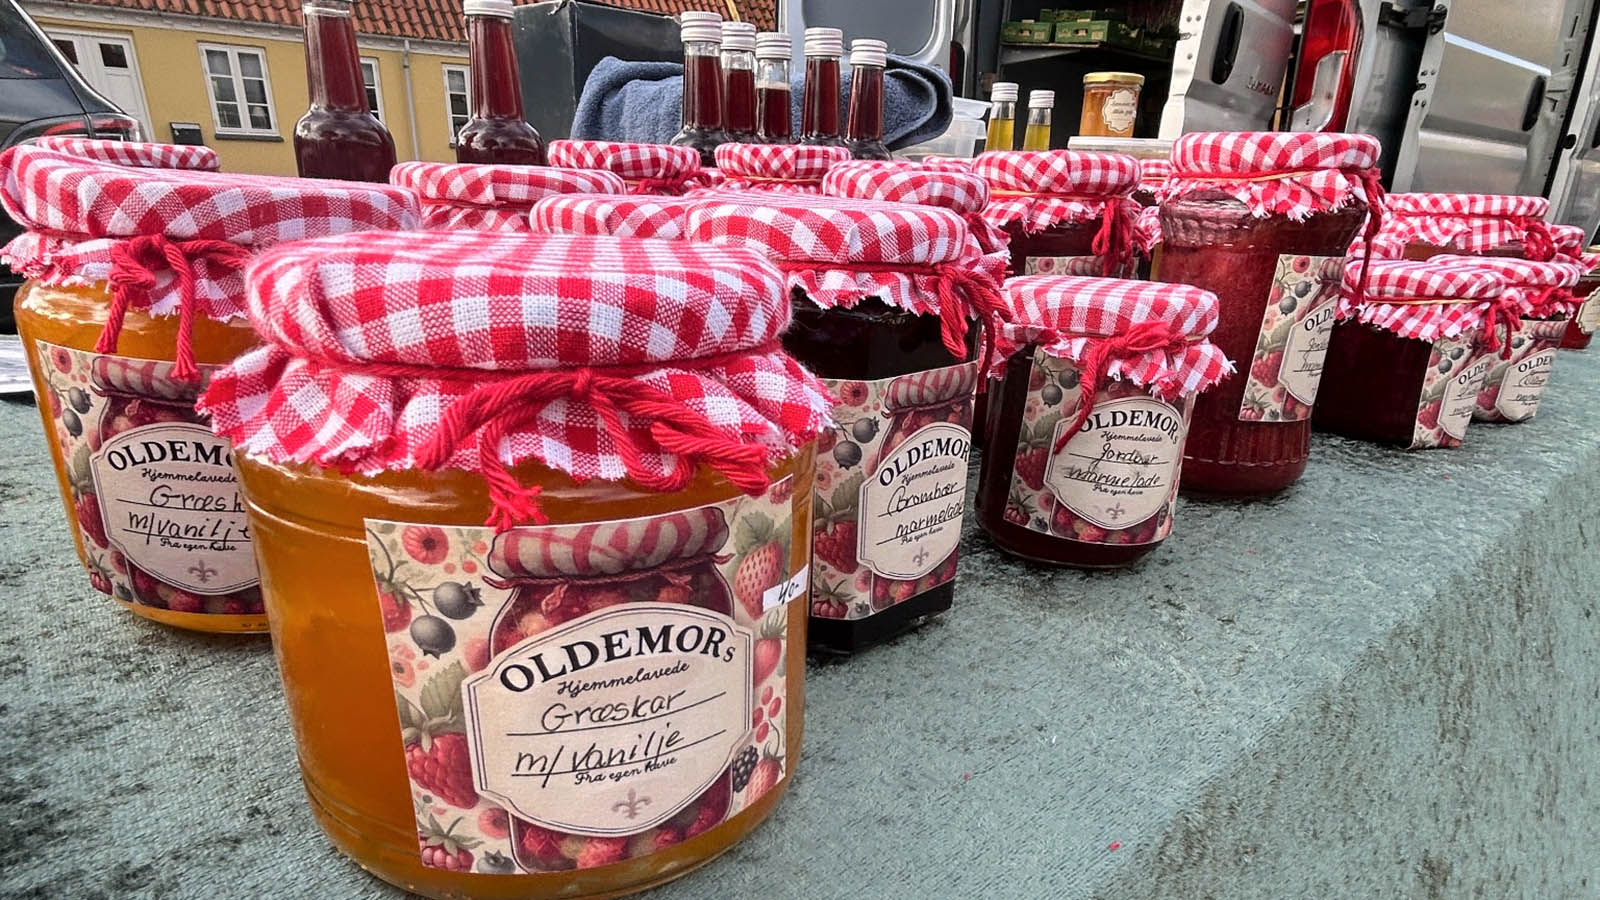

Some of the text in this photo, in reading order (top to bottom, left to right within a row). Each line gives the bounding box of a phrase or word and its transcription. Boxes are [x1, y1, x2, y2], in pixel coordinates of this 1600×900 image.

[1304, 307, 1334, 331] OLD
[141, 468, 238, 483] Hjemmelavede
[160, 537, 181, 548] Fra
[183, 541, 208, 551] egen
[557, 659, 691, 698] Hjemmelavede
[541, 690, 687, 732] Græskar
[574, 771, 607, 785] Fra
[609, 767, 642, 782] egen
